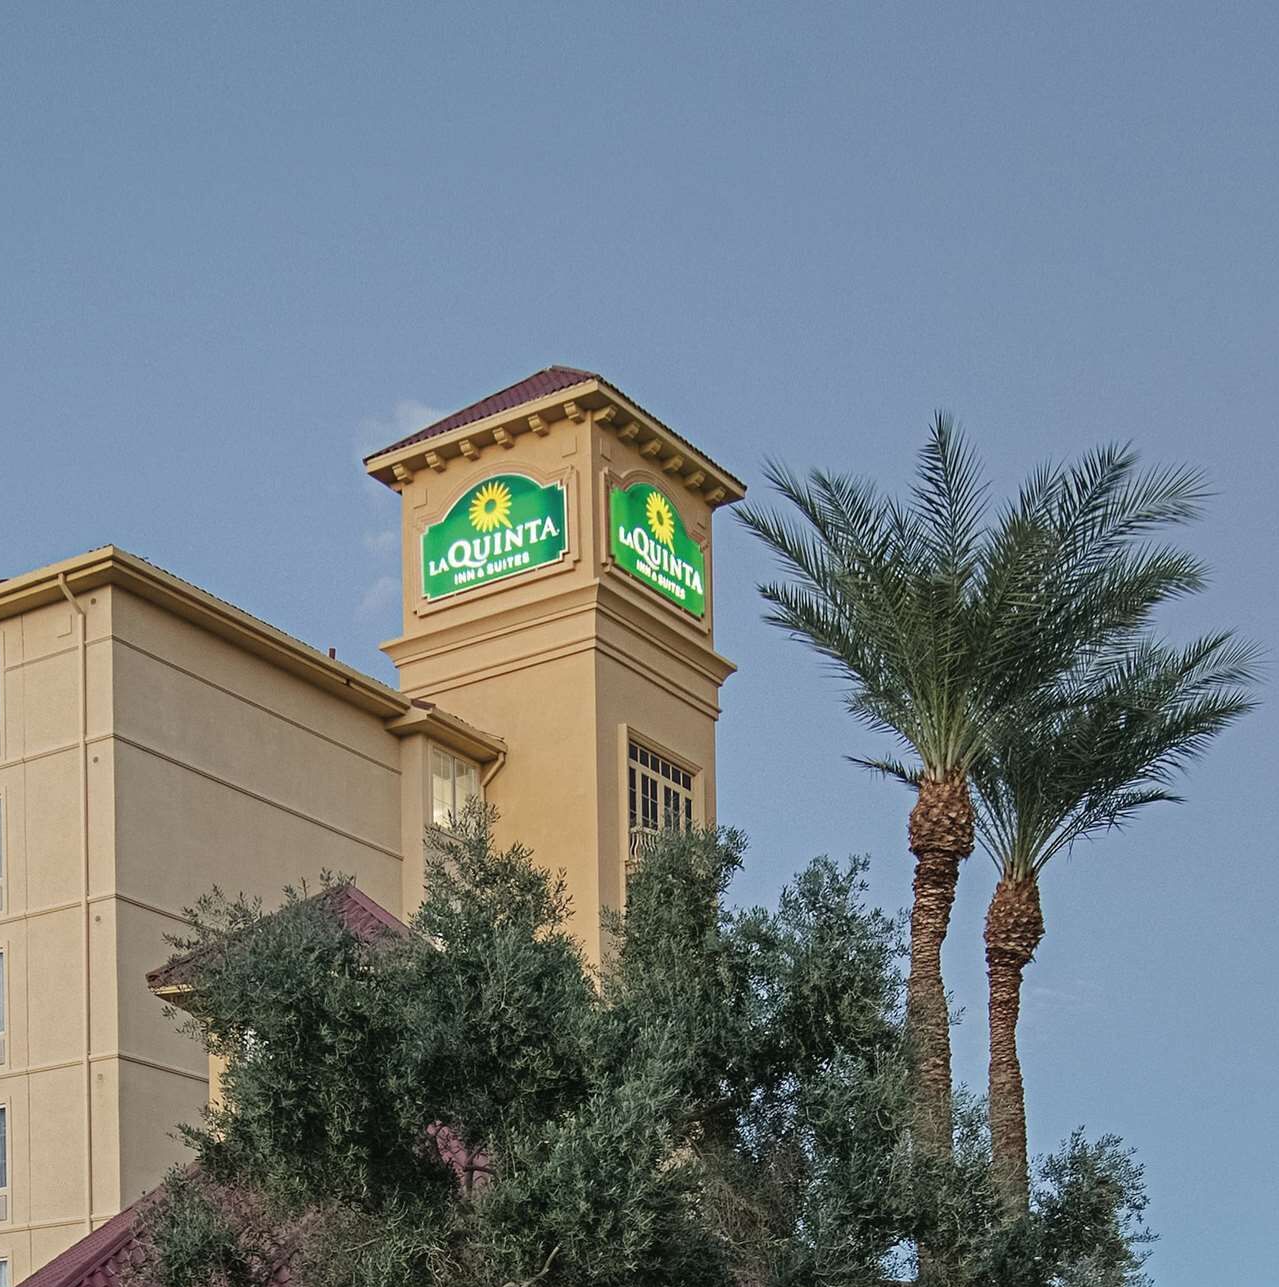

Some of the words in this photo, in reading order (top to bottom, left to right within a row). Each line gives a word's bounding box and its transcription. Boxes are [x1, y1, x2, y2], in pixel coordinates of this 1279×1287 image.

[429, 557, 450, 576] LA
[448, 515, 558, 568] QUINTA
[454, 570, 476, 585] INN
[477, 568, 485, 578] &
[487, 552, 530, 575] SUITES
[619, 526, 634, 549] LA
[633, 527, 703, 595] QUINTA
[636, 559, 652, 578] INN
[658, 574, 686, 600] SUITES
